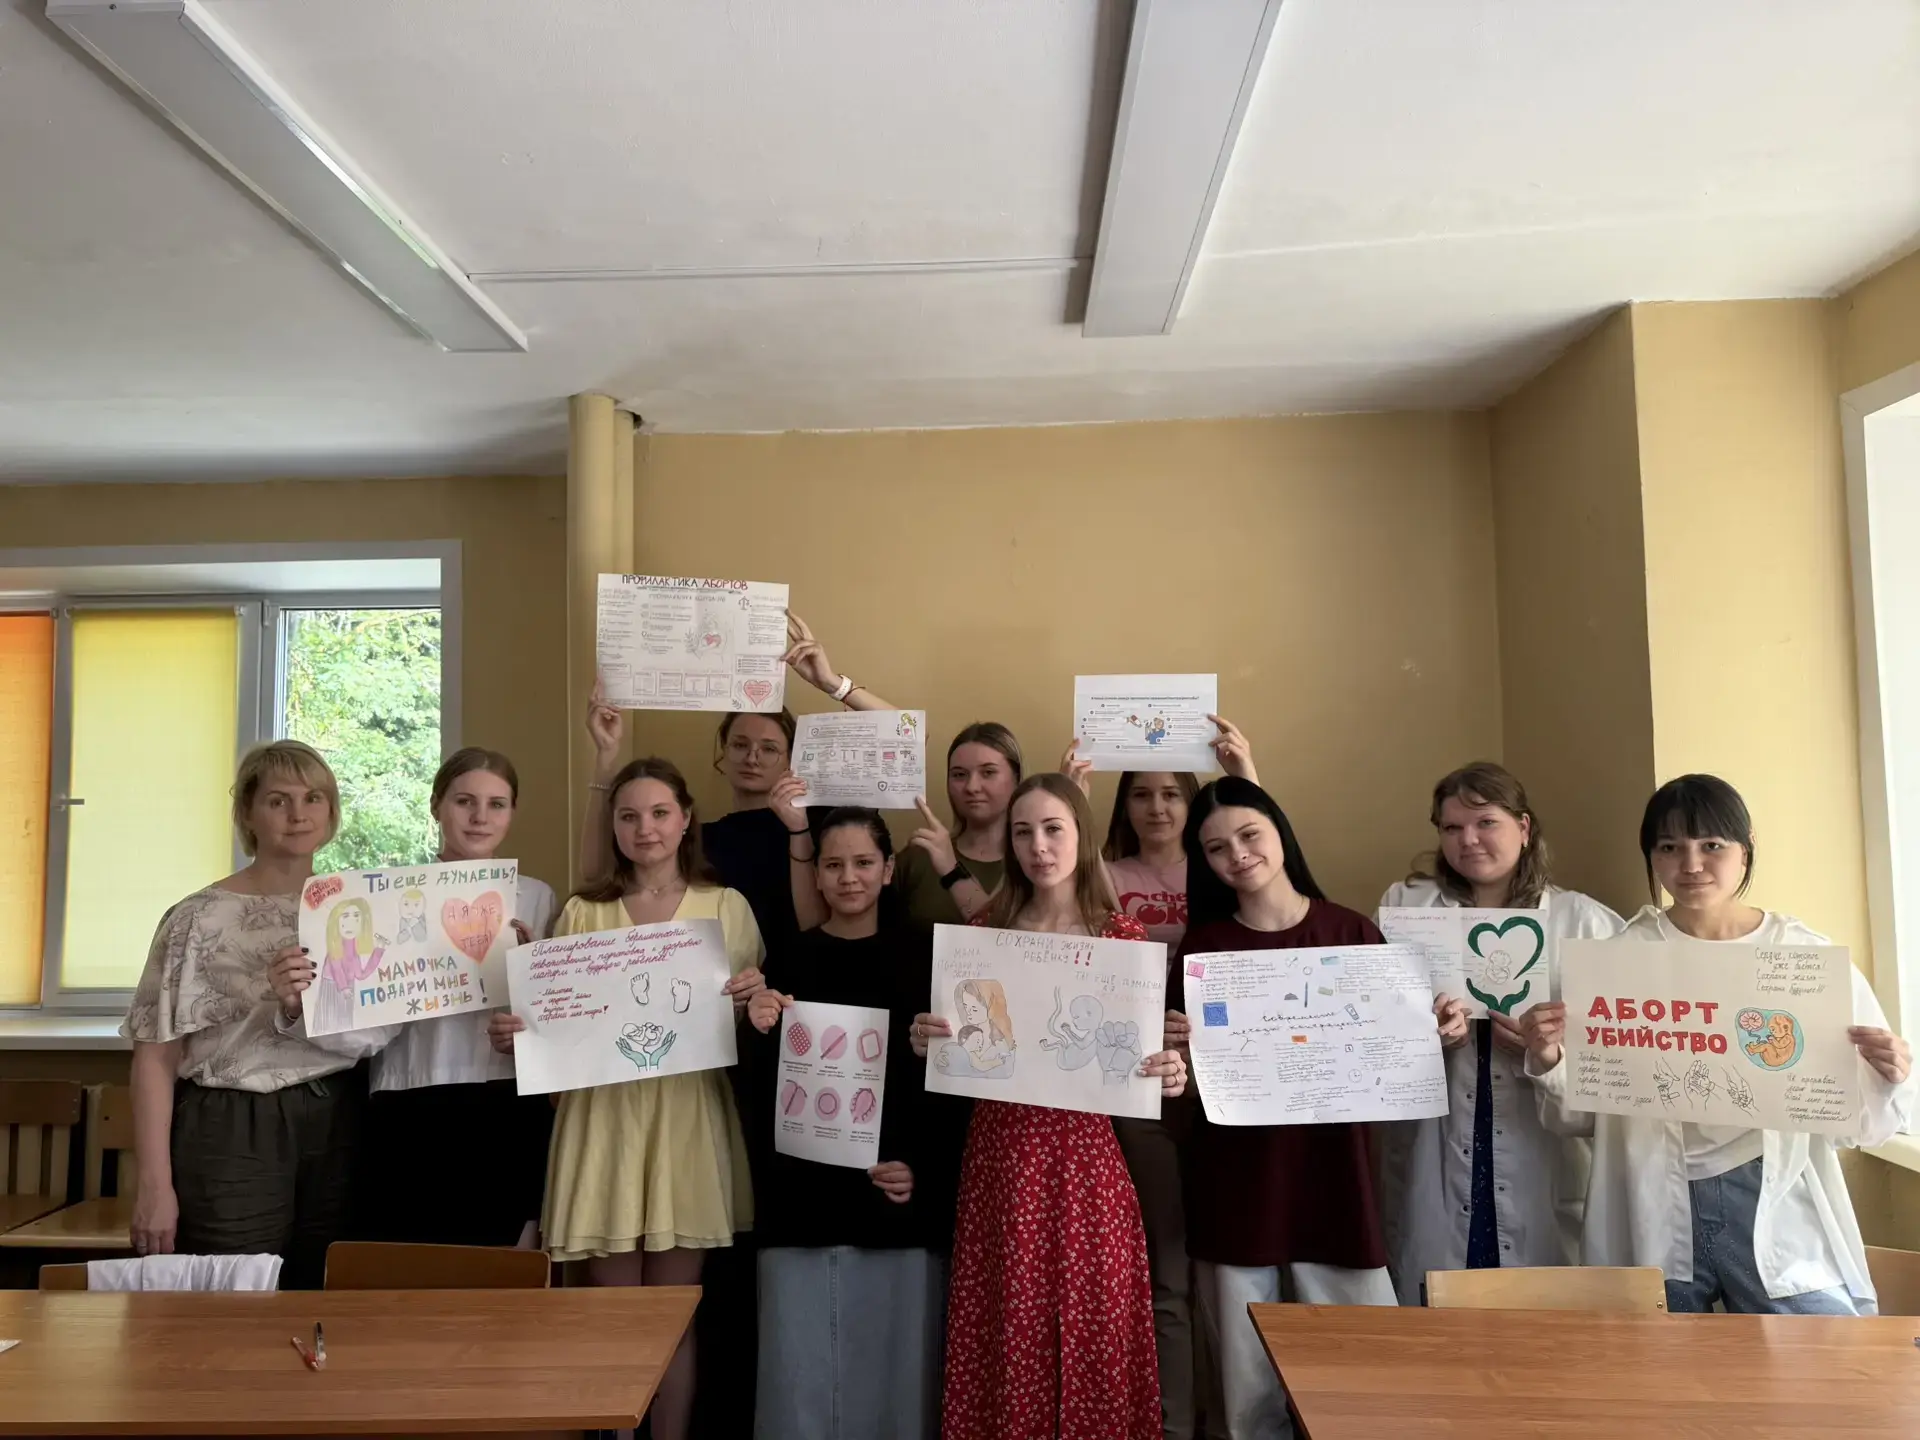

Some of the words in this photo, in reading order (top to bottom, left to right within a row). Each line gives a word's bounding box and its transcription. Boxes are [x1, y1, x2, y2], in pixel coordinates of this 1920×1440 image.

[622, 574, 698, 588] ПРОФИЛАКТИКА
[702, 578, 748, 590] АБОРТОВ
[461, 904, 469, 918] Я
[532, 937, 616, 958] Планирование
[995, 931, 1054, 950] СОХРАНИ
[377, 955, 458, 983] МАМОЧКА
[360, 977, 428, 1006] ПОДАРИ
[433, 972, 469, 991] МНЕ
[1587, 996, 1718, 1025] АБОРТ
[1585, 1025, 1728, 1055] УБИЙСТВО
